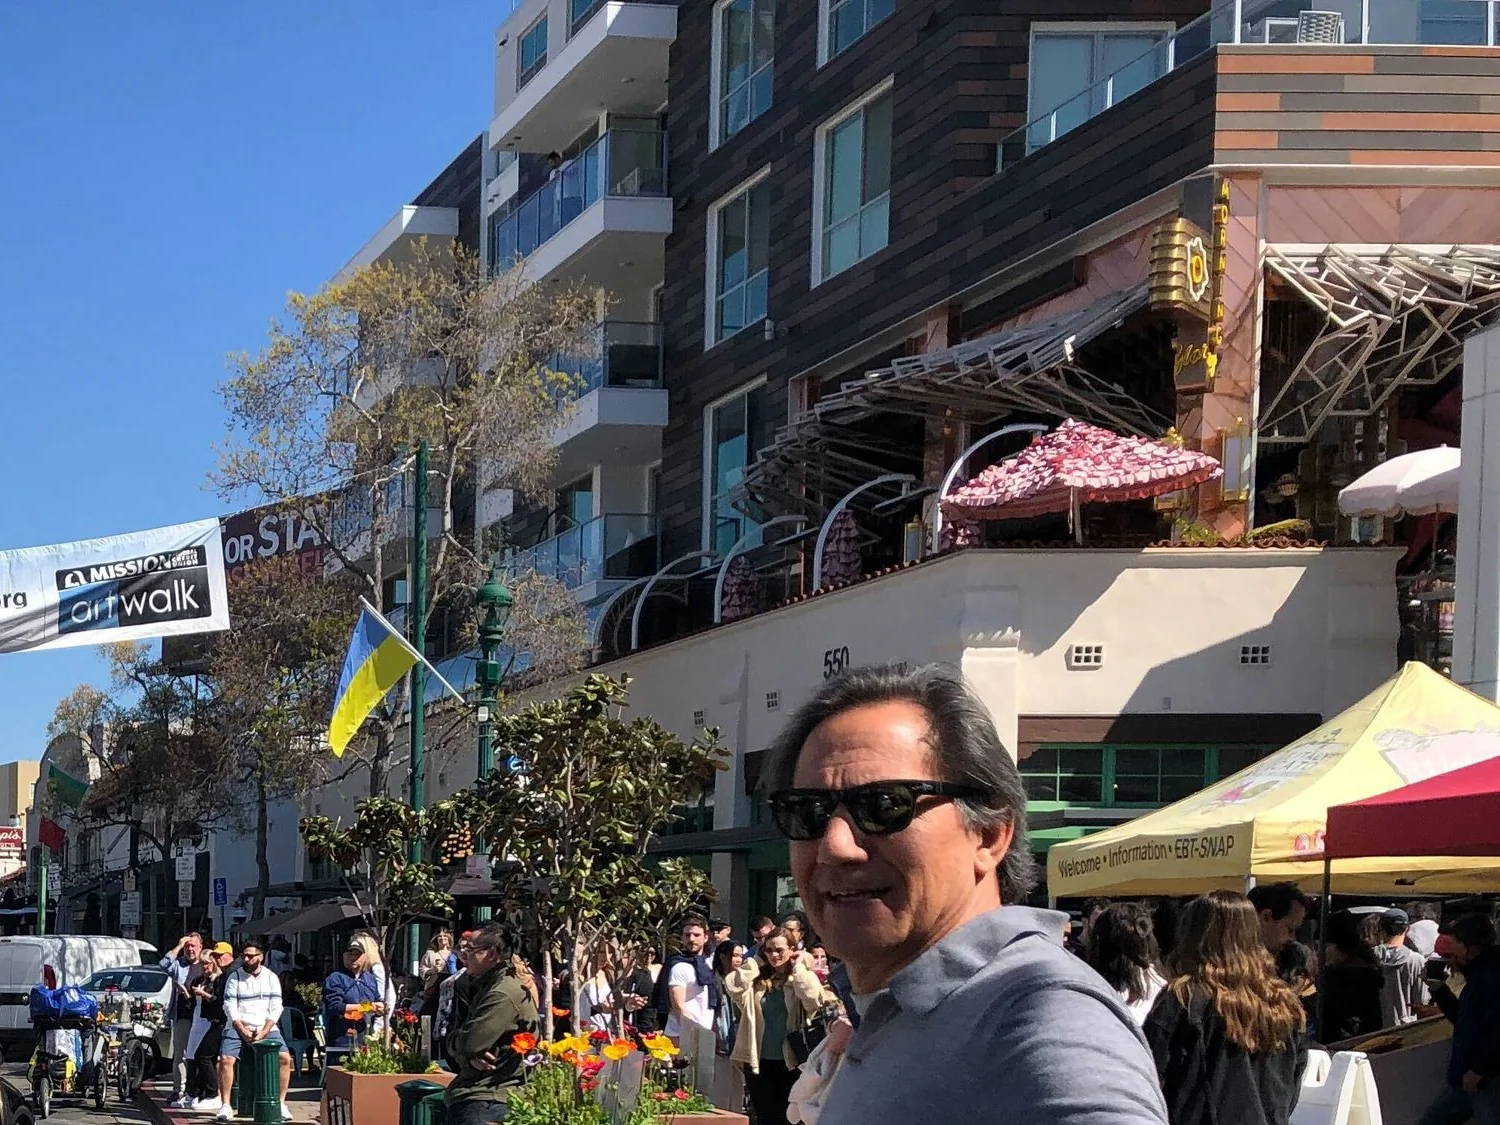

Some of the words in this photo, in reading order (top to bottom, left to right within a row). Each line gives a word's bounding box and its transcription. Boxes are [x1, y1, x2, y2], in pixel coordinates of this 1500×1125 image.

[220, 524, 254, 565] OR
[90, 554, 172, 583] MISSION
[823, 646, 850, 680] 550
[1058, 856, 1101, 878] Welcome
[1108, 840, 1168, 868] Information
[1174, 835, 1235, 860] EBT-SNAP
